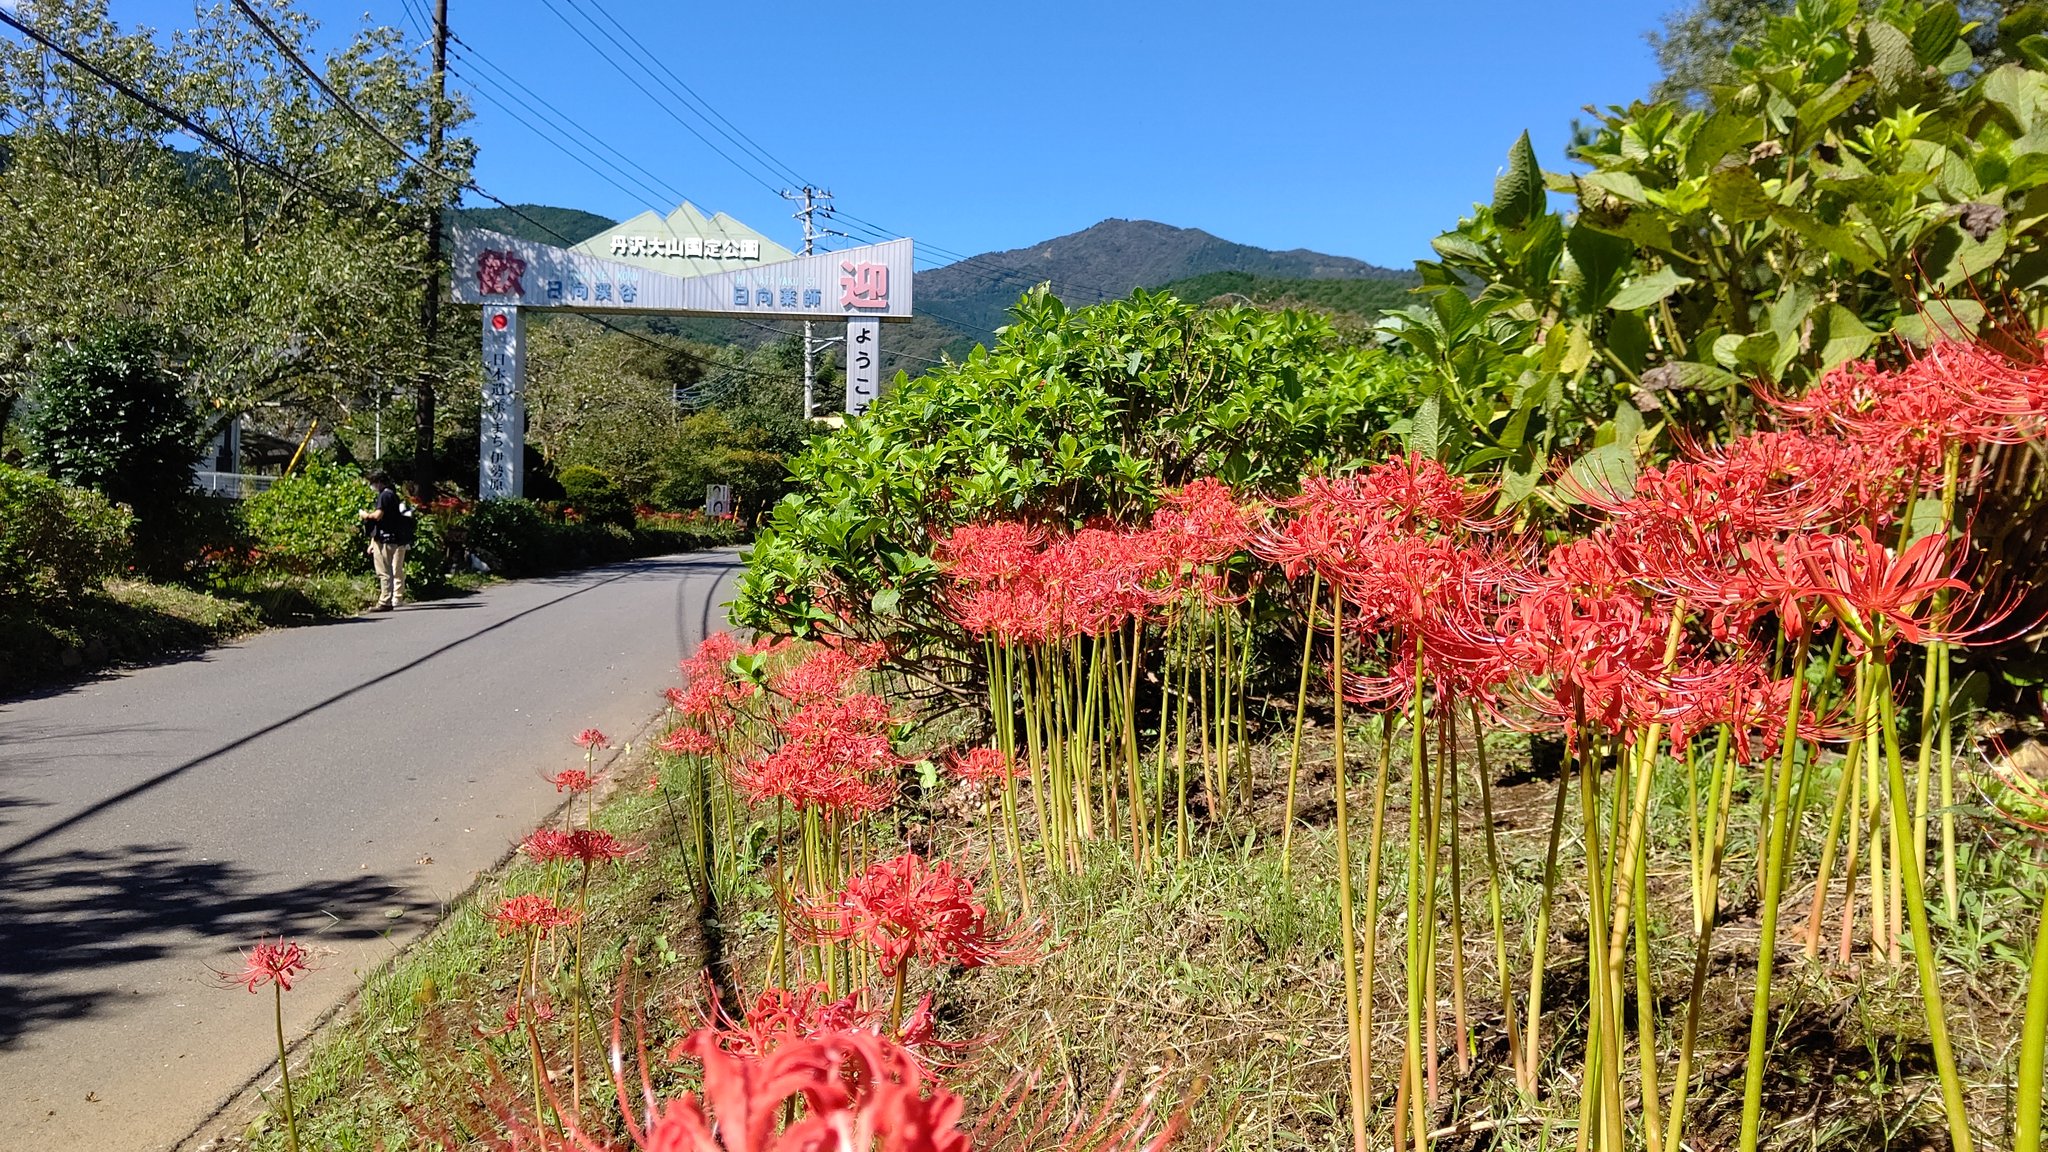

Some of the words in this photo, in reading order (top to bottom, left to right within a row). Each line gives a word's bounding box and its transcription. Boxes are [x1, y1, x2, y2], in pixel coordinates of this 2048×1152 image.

[609, 234, 761, 261] 丹沢大山国定公園
[734, 287, 821, 308] 日向薬師
[840, 260, 889, 311] 迎
